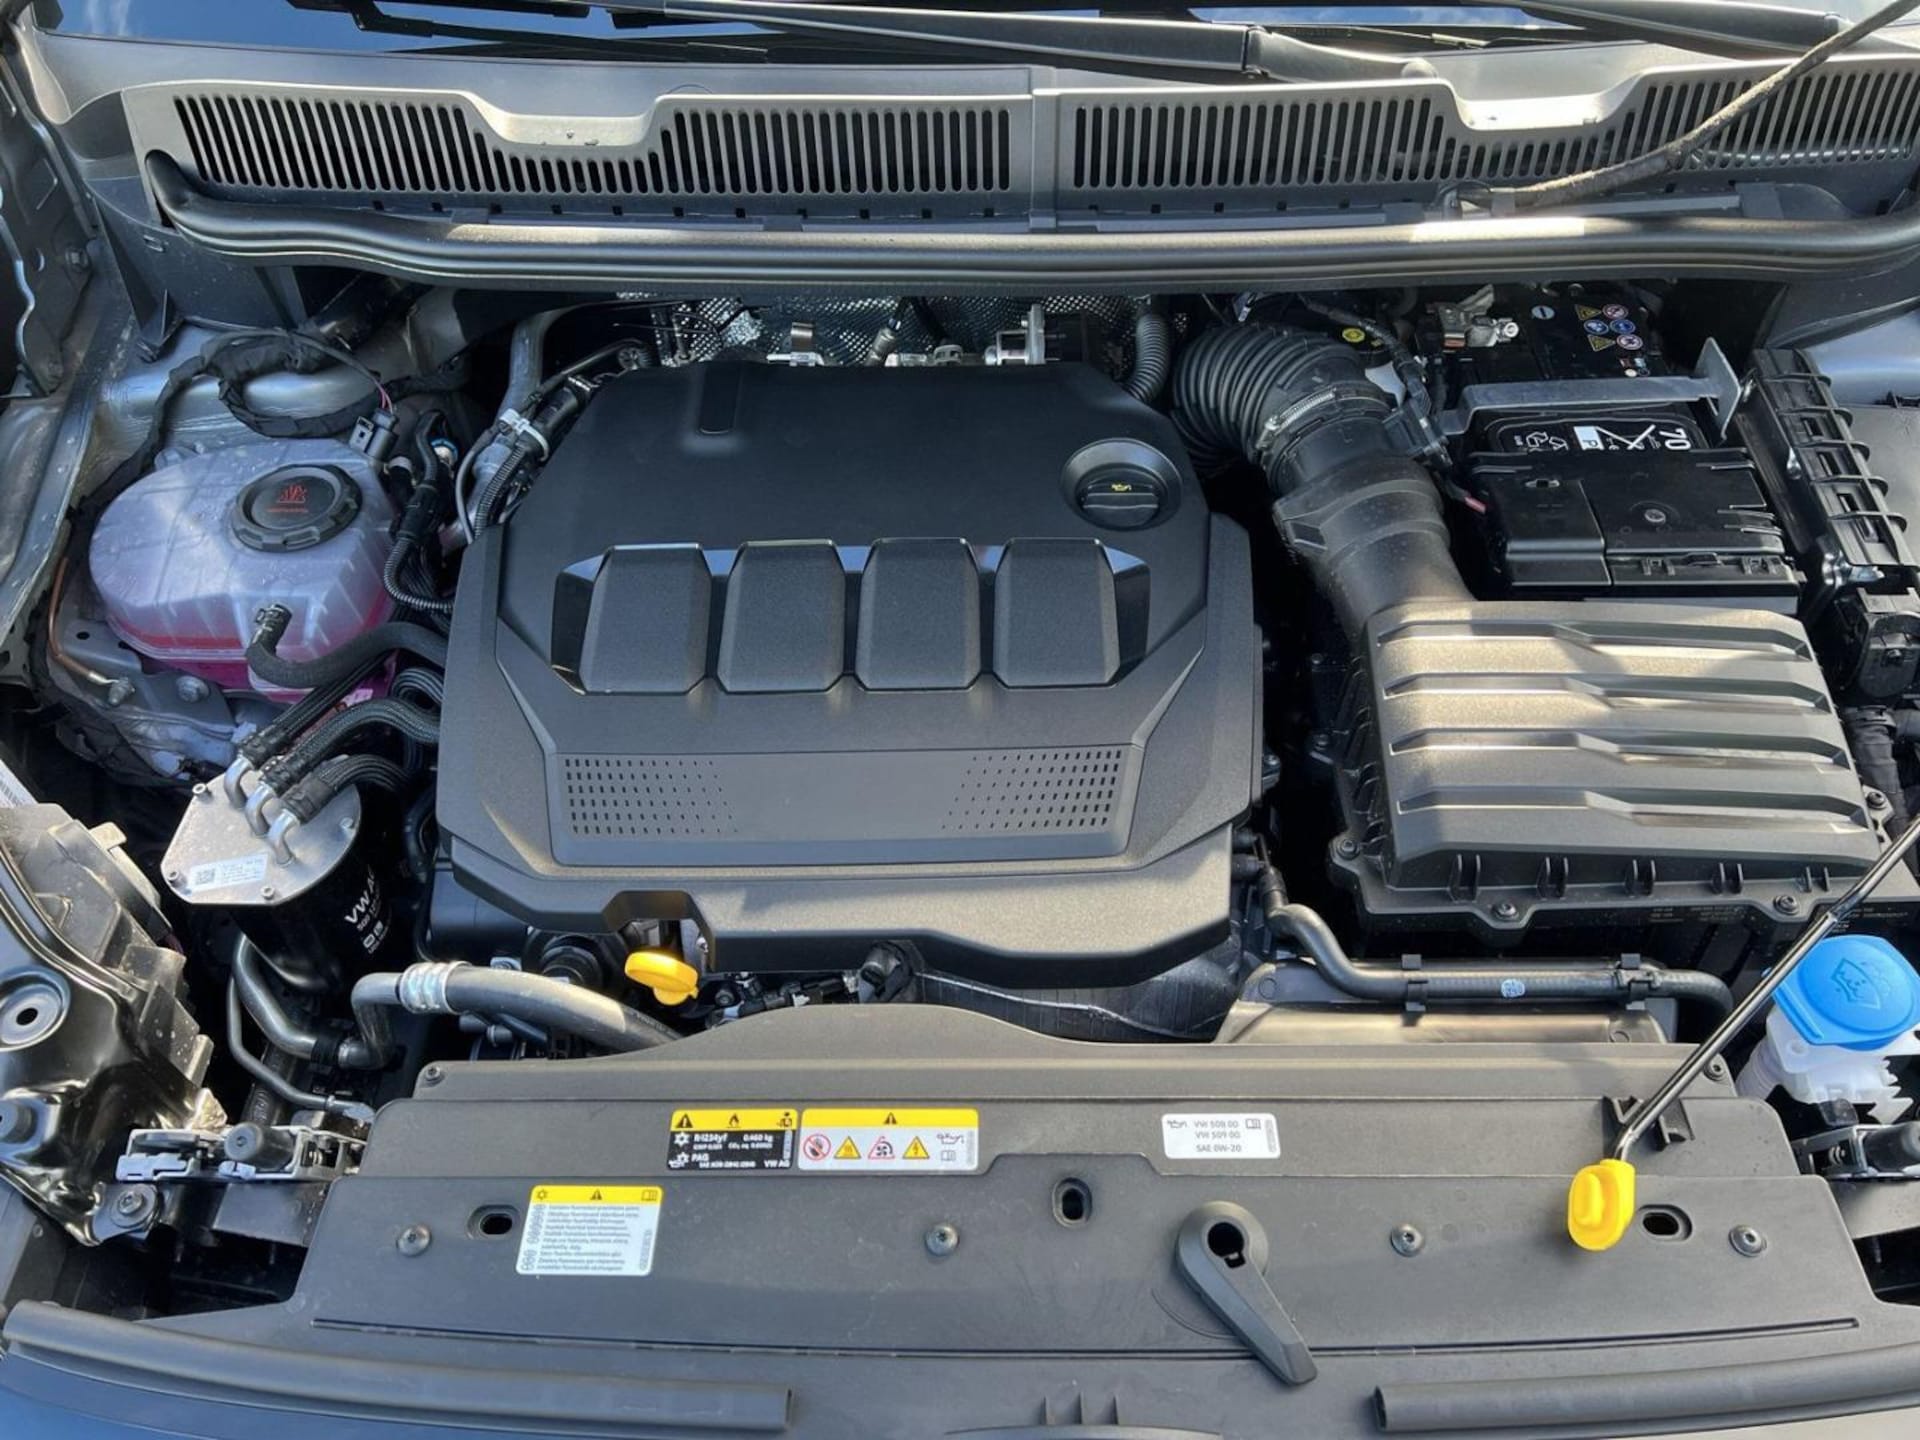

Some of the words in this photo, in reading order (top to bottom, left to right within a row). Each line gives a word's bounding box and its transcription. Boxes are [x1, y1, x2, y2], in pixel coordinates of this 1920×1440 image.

[1659, 427, 1691, 450] 70
[344, 890, 370, 924] VW
[1193, 1119, 1208, 1129] VW
[1227, 1119, 1239, 1129] 00
[764, 1133, 774, 1144] kg
[1195, 1130, 1209, 1139] VW
[1211, 1130, 1227, 1139] 509
[1228, 1130, 1241, 1139] 00
[1196, 1143, 1212, 1152] SAE
[1213, 1143, 1242, 1152] 0W-20
[691, 1153, 710, 1162] PAG
[764, 1160, 778, 1168] VW
[779, 1160, 791, 1168] AG
